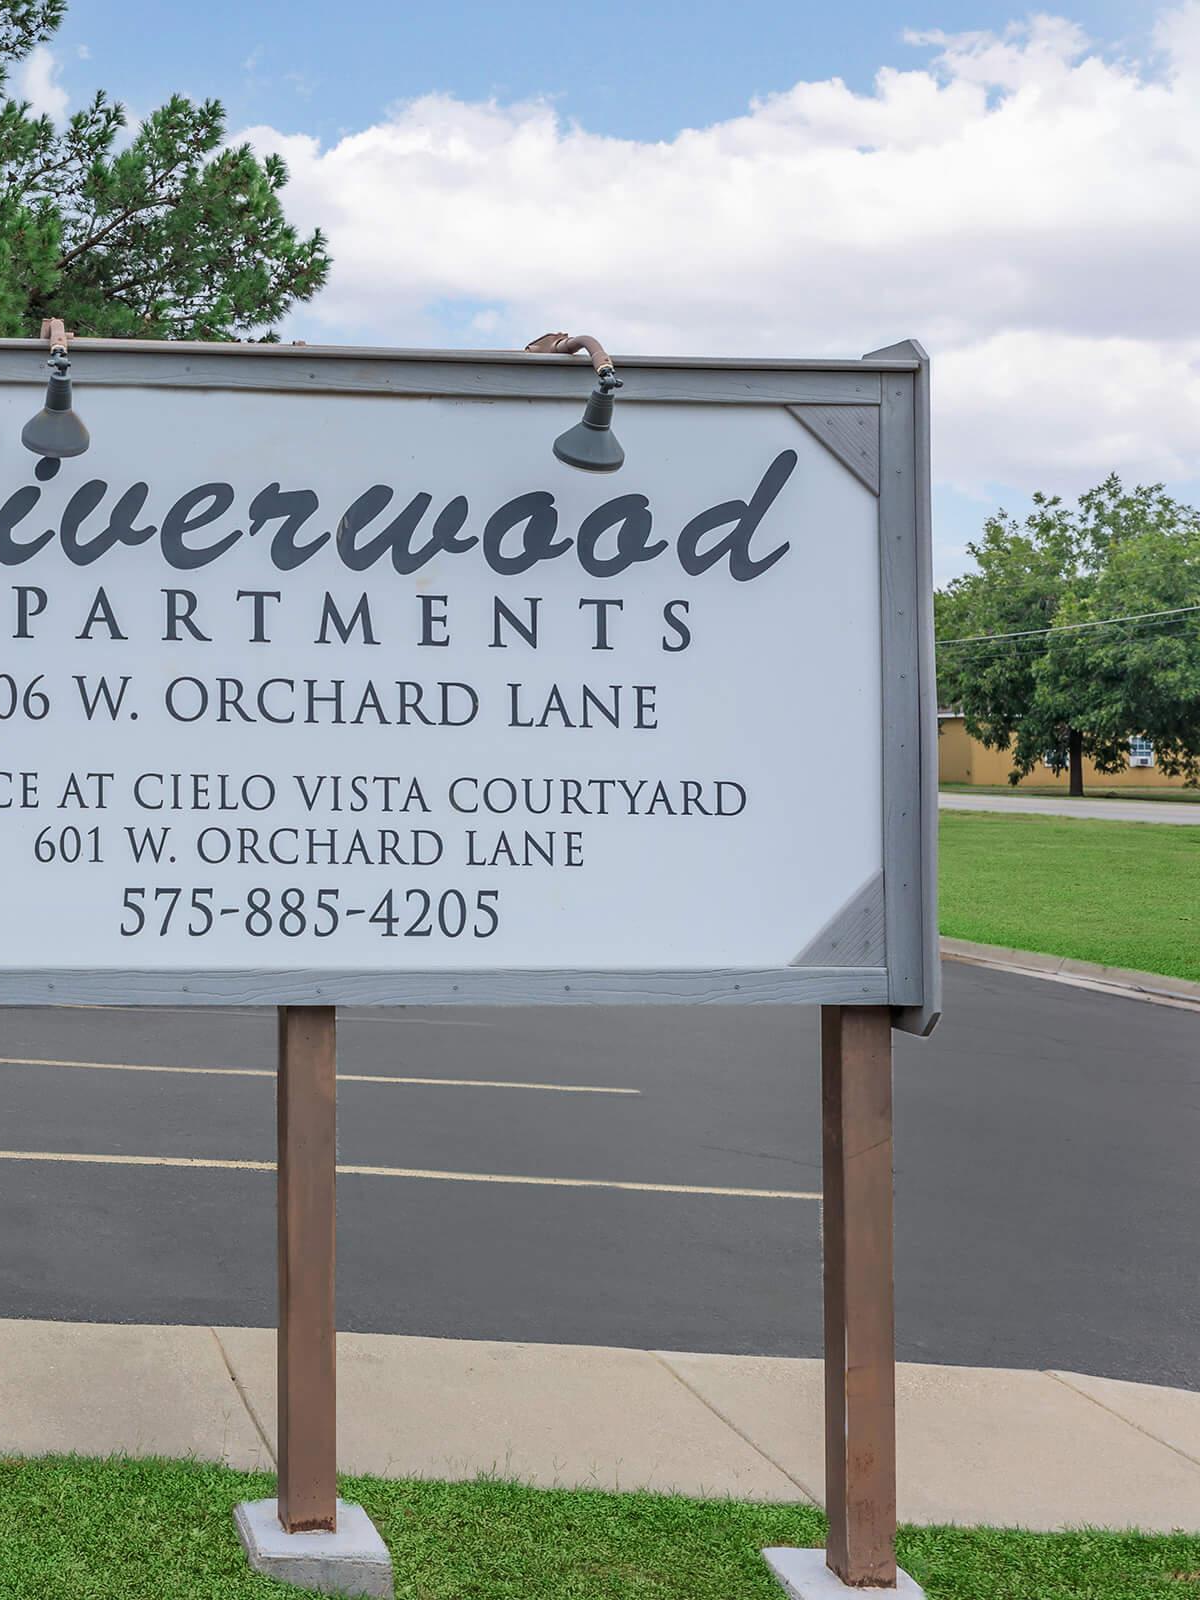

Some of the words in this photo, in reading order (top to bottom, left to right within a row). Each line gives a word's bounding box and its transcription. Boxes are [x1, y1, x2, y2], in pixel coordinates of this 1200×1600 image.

[71, 675, 140, 721] W.
[165, 676, 480, 727] ORCHARD
[506, 682, 659, 730] LANE
[56, 772, 115, 809] AT
[133, 773, 277, 811] CIELO
[292, 775, 434, 813] VISTA
[448, 776, 748, 817] COURTYARD
[34, 825, 105, 864] 601
[123, 826, 179, 864] W.
[196, 826, 445, 866] ORCHARD
[464, 830, 585, 868] LANE
[120, 887, 500, 939] 575-885-4205
